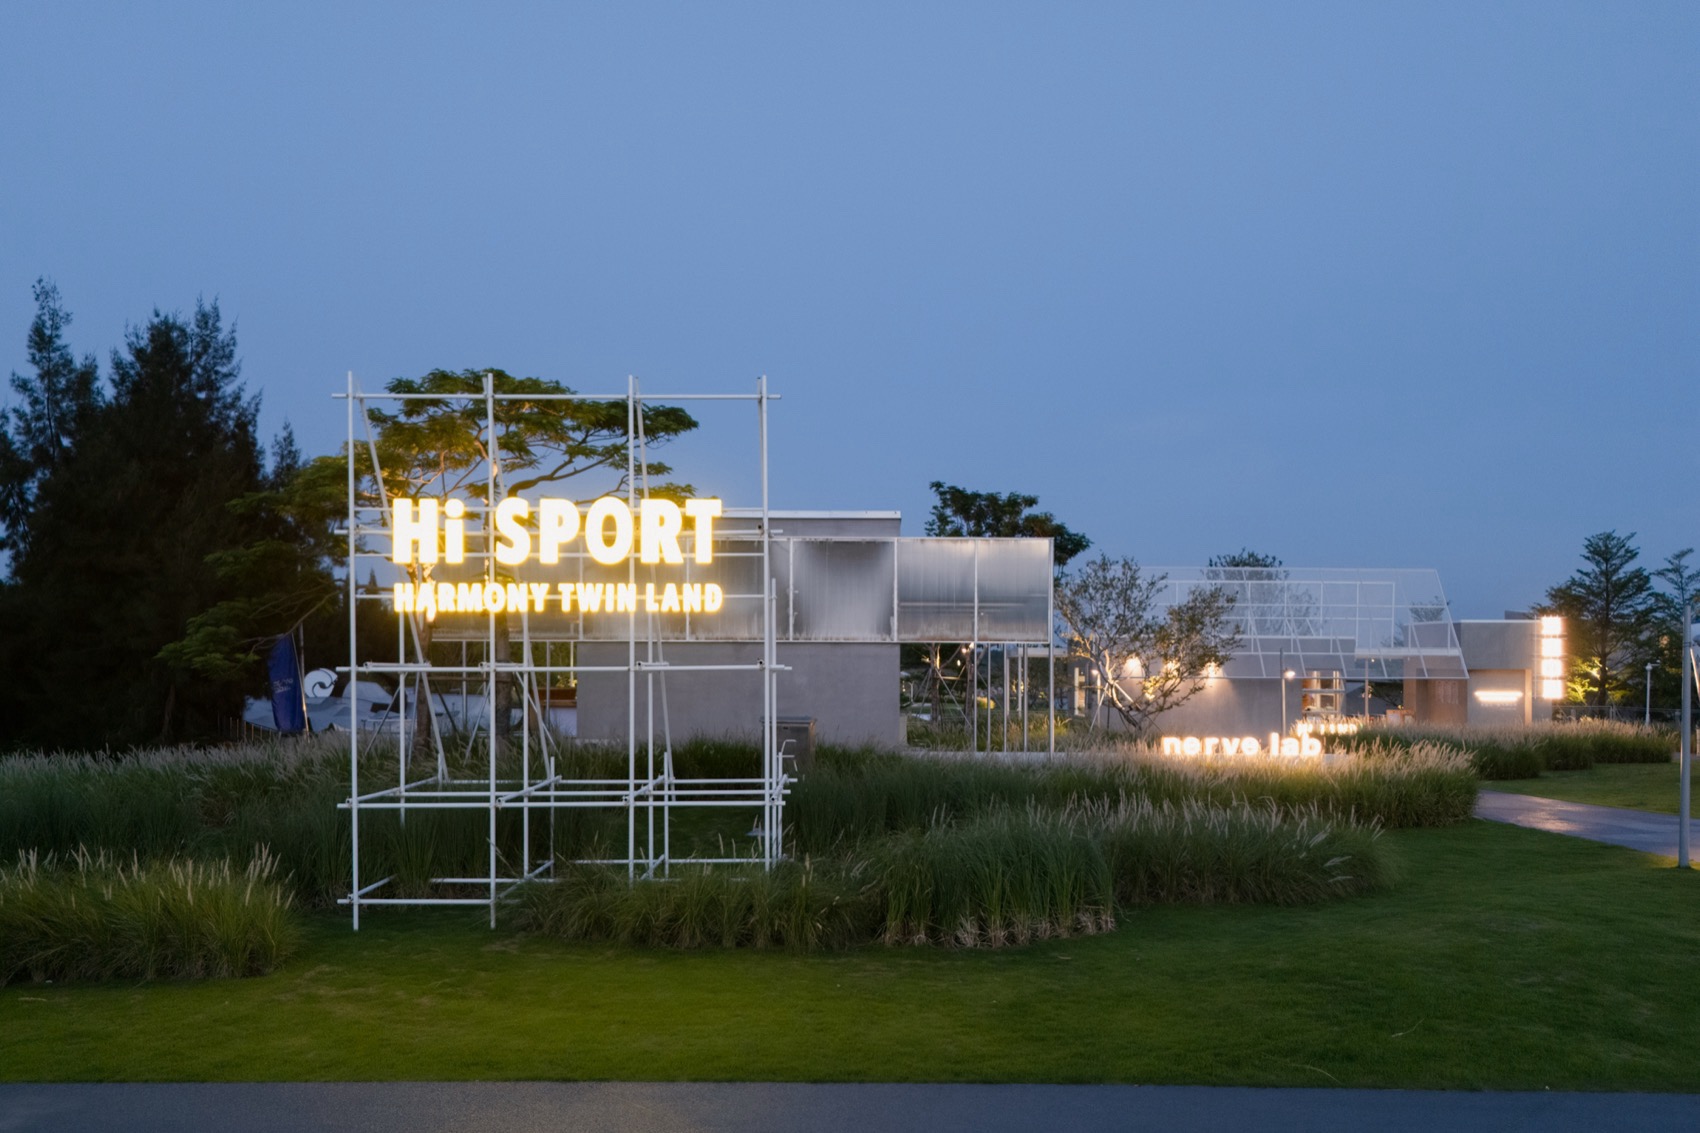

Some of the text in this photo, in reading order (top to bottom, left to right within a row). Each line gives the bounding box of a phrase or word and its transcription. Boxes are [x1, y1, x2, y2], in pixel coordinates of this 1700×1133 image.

[392, 497, 722, 565] Hi SPORT
[393, 582, 723, 612] HARMONY TWIN LAND
[1161, 732, 1322, 756] nerve lab
